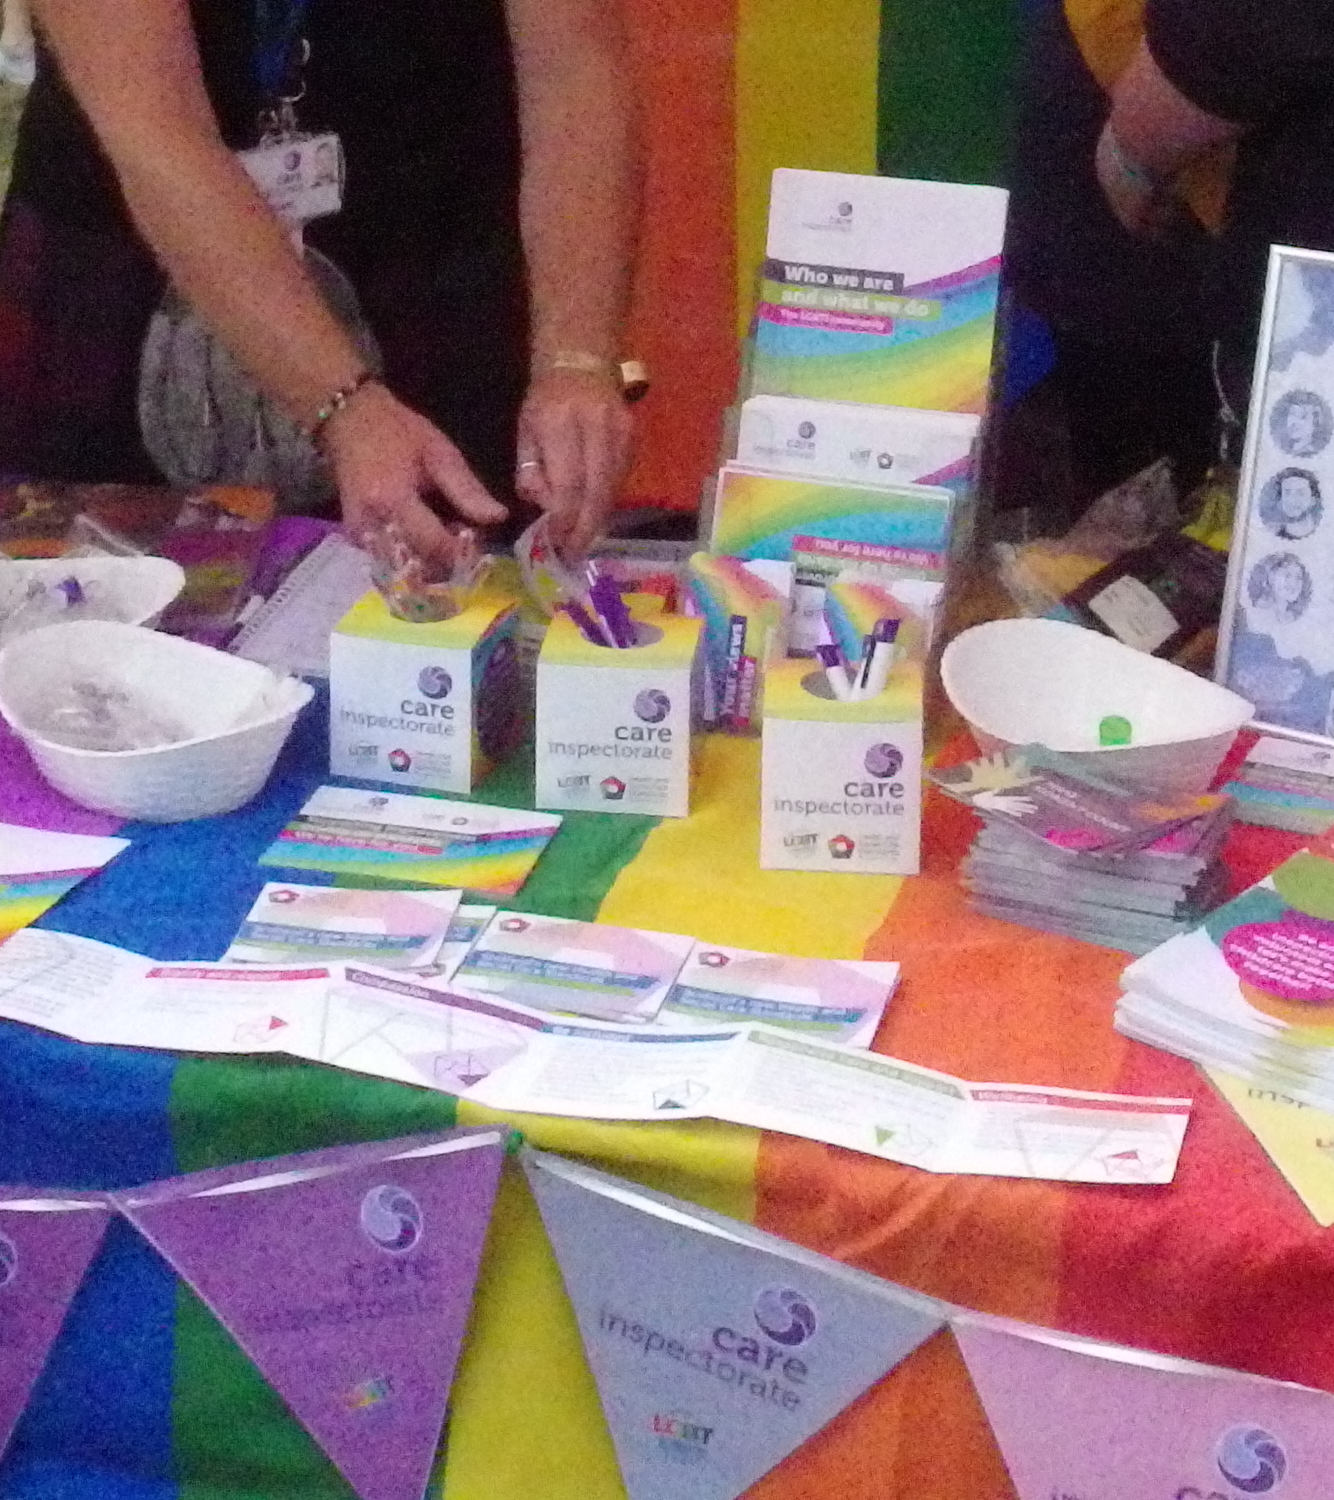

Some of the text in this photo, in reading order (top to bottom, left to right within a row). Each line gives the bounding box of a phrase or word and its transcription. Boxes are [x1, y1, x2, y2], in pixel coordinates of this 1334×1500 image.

[783, 265, 894, 292] Who we are
[823, 291, 870, 312] what
[875, 299, 905, 316] we
[904, 297, 930, 318] do
[400, 696, 456, 721] care
[340, 707, 456, 738] inspectorate
[614, 721, 673, 744] care
[548, 738, 673, 763] inspectorate
[844, 776, 905, 799] care
[774, 797, 905, 820] inspectorate
[597, 1304, 802, 1413] inspectorate
[711, 1322, 809, 1387] care
